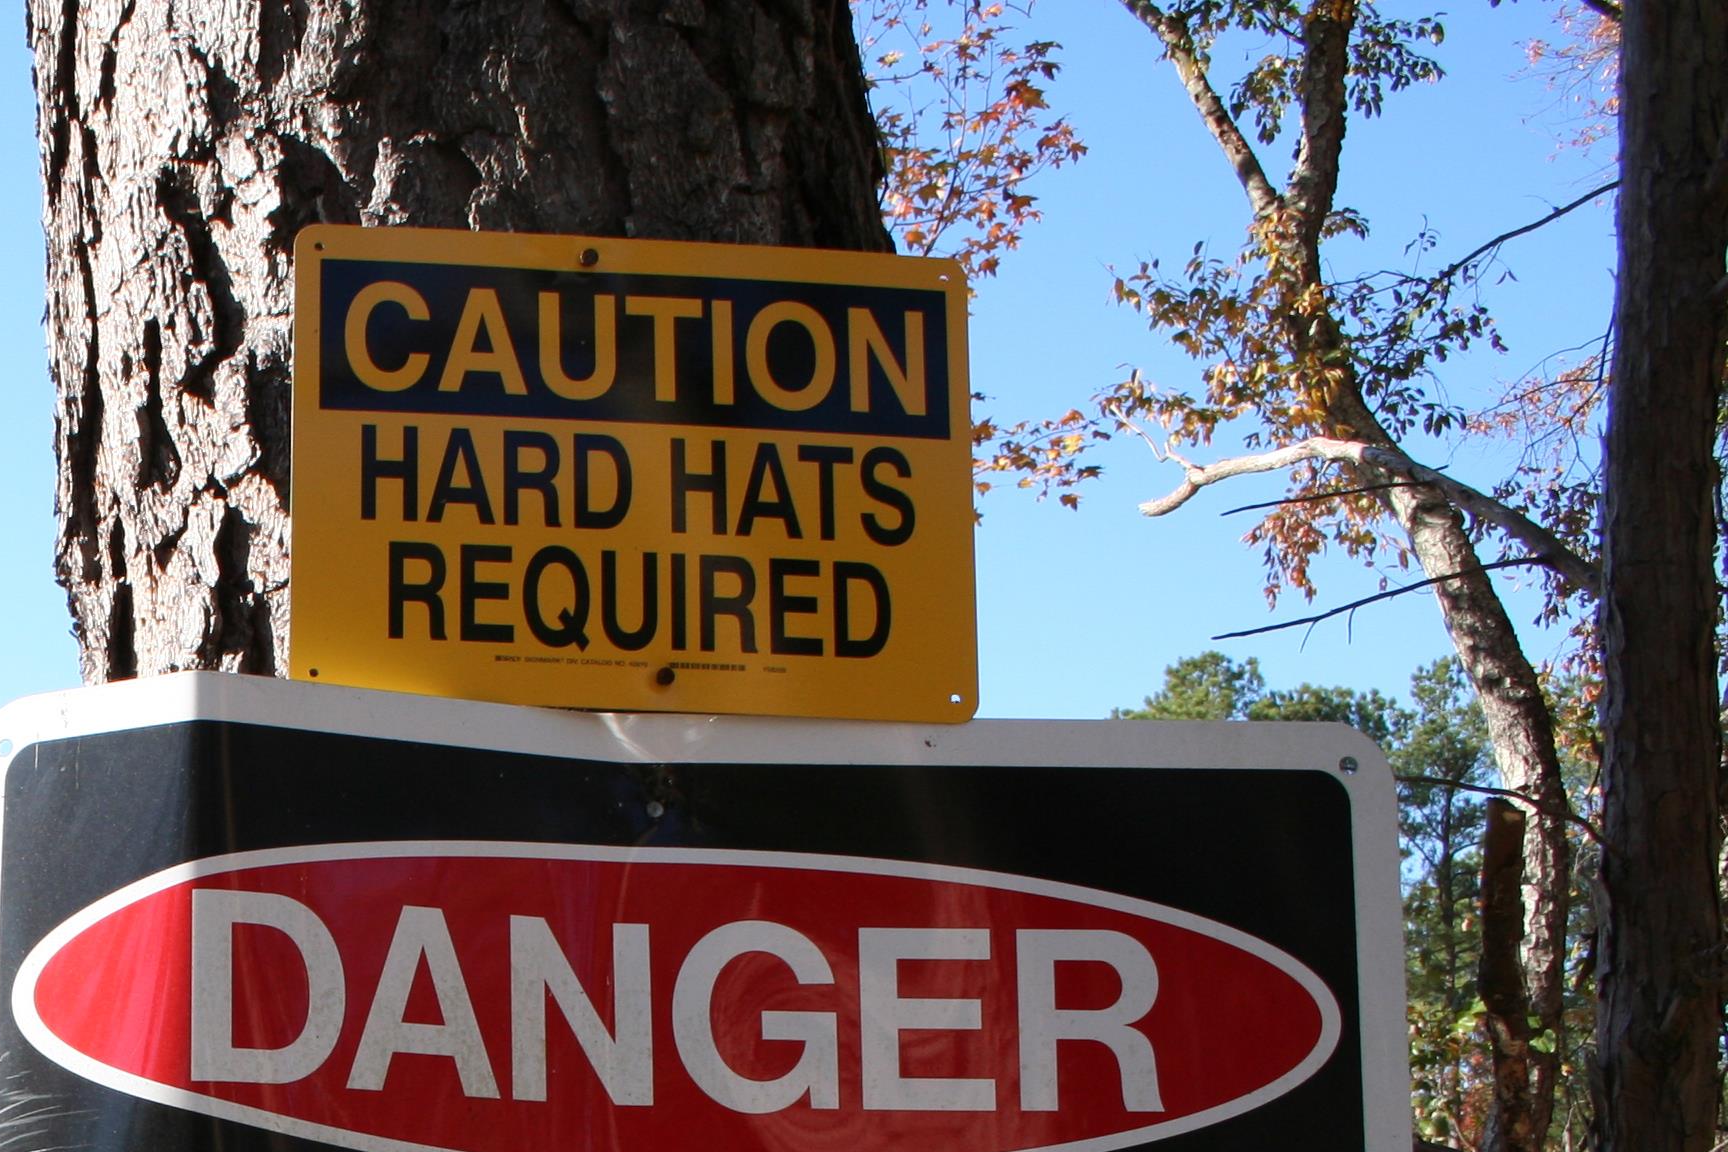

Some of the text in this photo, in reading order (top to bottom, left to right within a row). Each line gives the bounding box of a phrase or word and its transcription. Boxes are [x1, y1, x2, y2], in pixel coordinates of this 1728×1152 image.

[346, 281, 925, 414] CAUTION
[362, 424, 915, 546] HARD HATS
[389, 541, 891, 657] REQUIRED
[191, 887, 1166, 1113] DANGER
